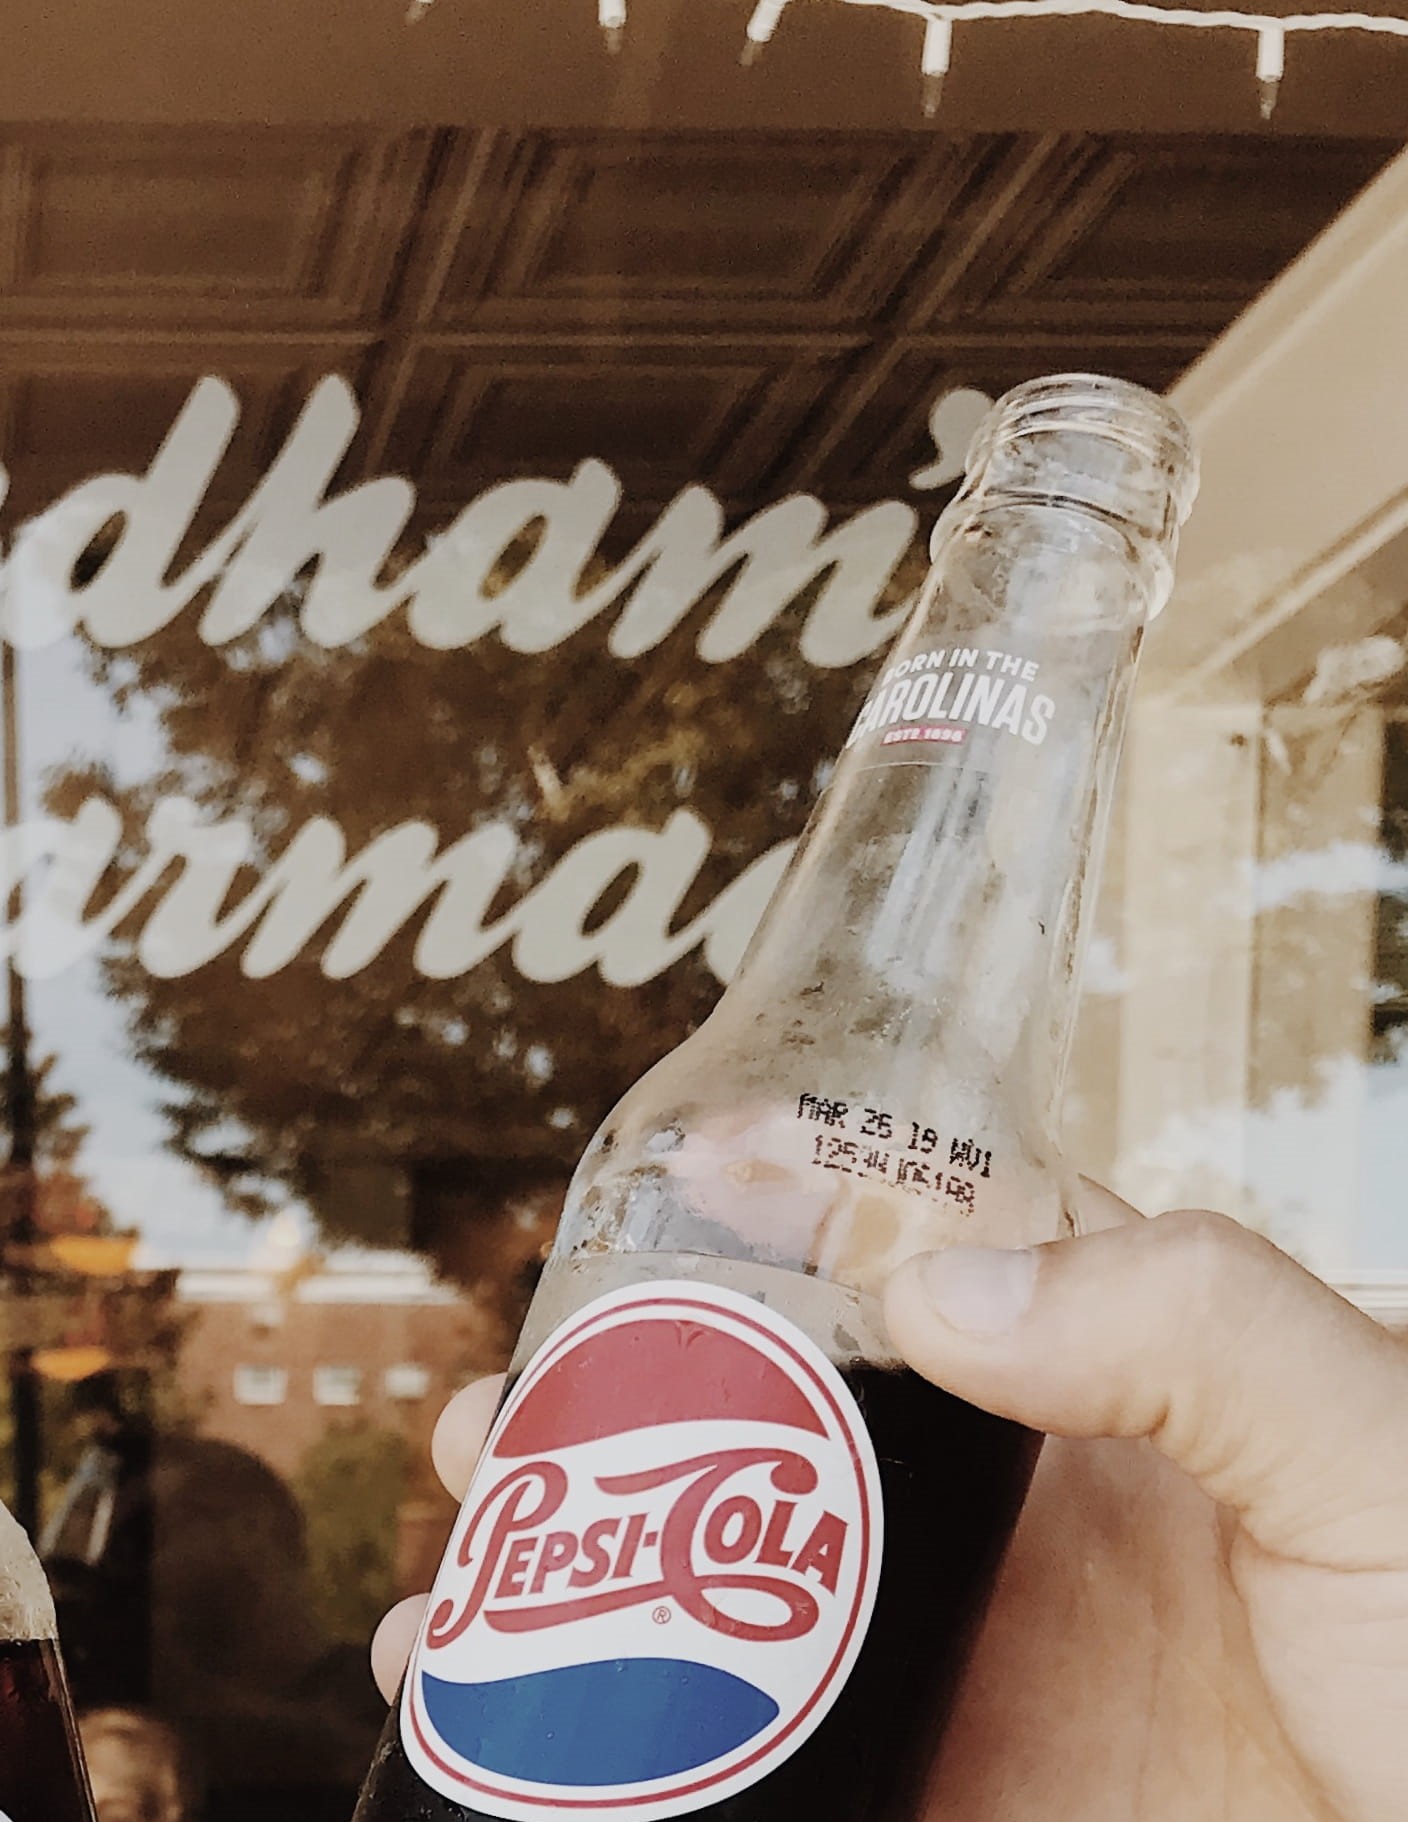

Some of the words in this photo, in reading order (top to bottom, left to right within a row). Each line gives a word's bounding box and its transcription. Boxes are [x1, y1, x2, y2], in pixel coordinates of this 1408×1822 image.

[881, 649, 945, 689] BORN
[949, 647, 980, 669] IN
[987, 650, 1040, 683] THE
[844, 671, 1056, 747] CAROLINAS
[426, 1446, 850, 1651] PEPSI-COLA
